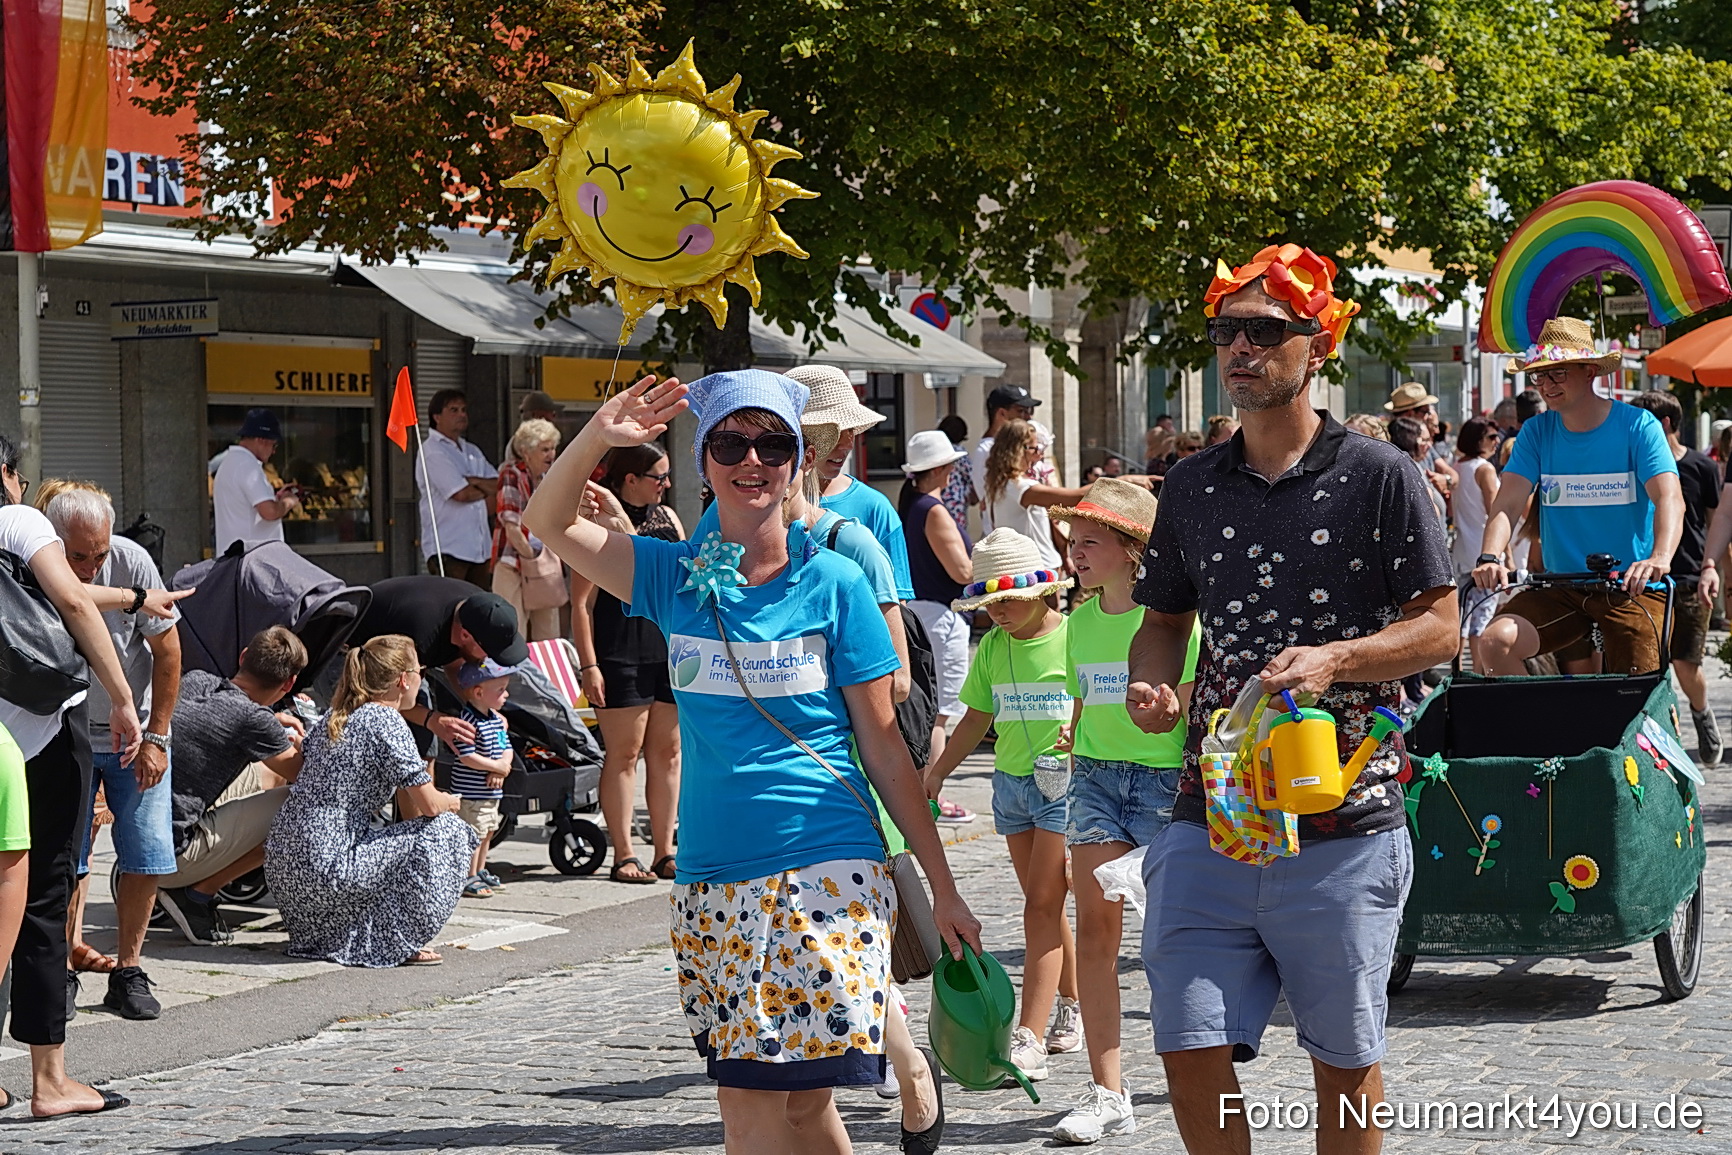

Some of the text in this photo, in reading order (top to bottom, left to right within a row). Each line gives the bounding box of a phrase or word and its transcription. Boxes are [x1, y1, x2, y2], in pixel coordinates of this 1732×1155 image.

[77, 302, 90, 315] 41
[121, 304, 208, 322] NEUMARKTER
[137, 323, 193, 335] Nachrichten
[275, 371, 371, 392] SCHLIERF
[1566, 482, 1585, 491] Freie
[711, 651, 815, 671] Free Grundschule
[709, 670, 724, 680] im
[747, 673, 758, 683] St.
[759, 671, 798, 683] Marien
[1094, 673, 1118, 684] Freie
[1094, 686, 1103, 694] im
[1028, 703, 1037, 711] St.
[1038, 702, 1065, 711] Marien
